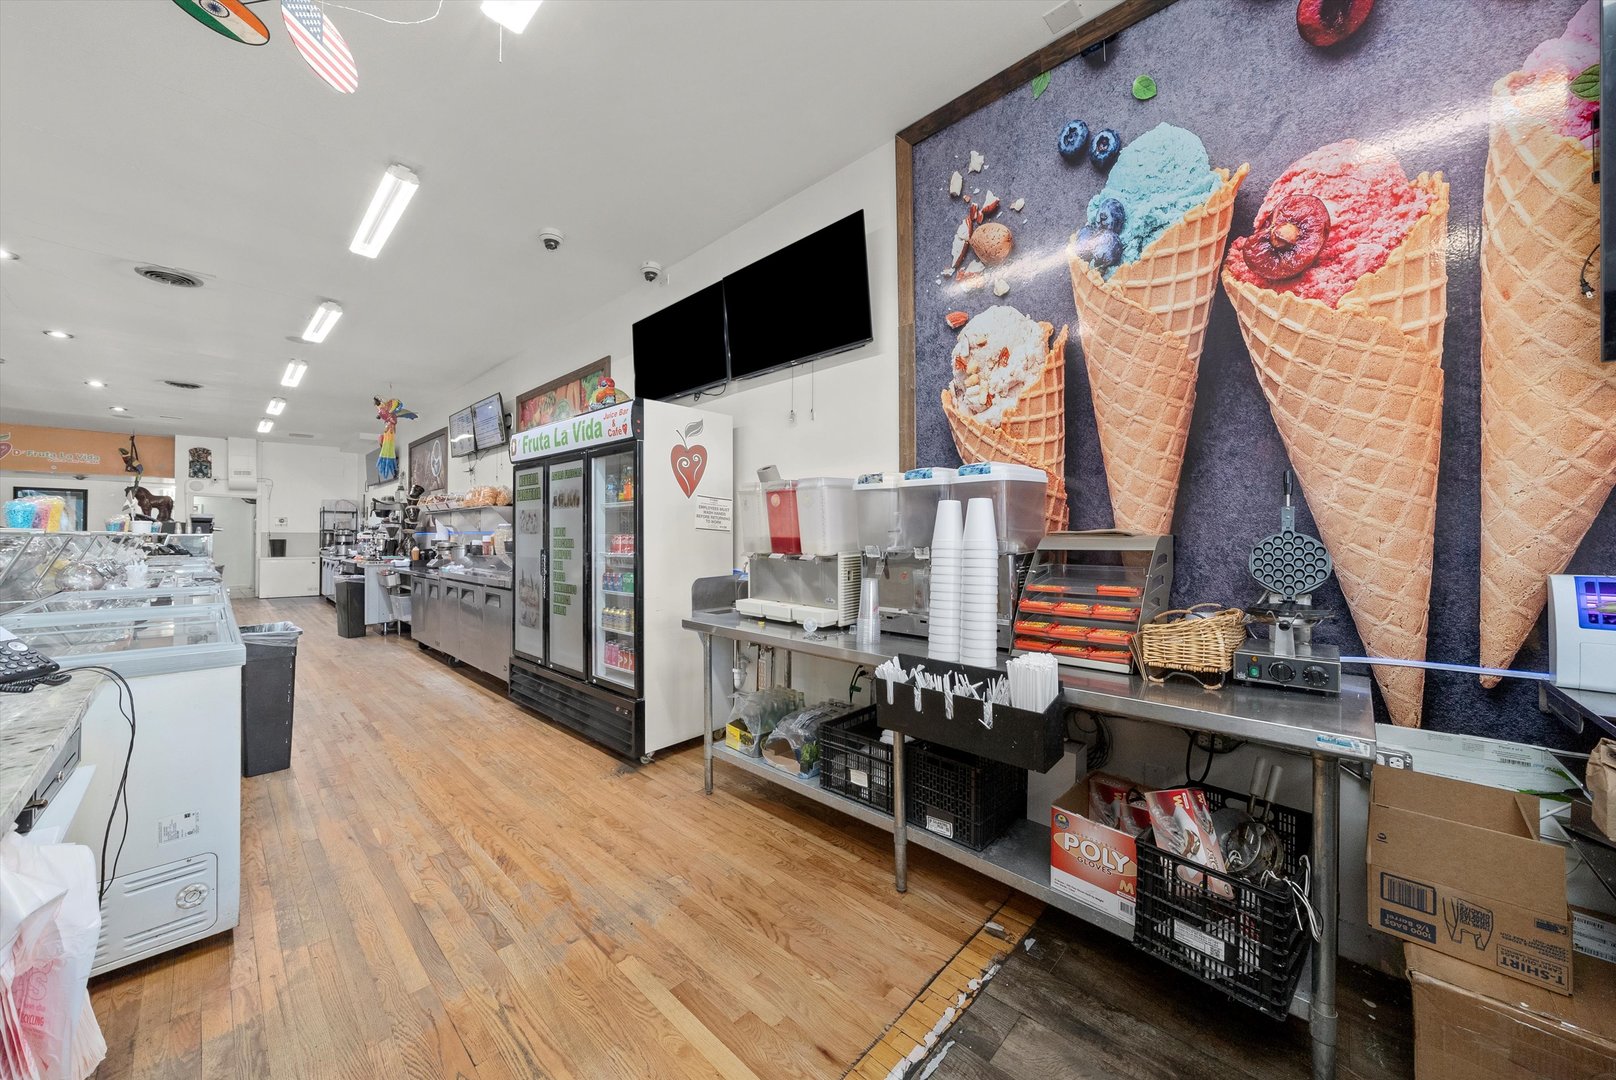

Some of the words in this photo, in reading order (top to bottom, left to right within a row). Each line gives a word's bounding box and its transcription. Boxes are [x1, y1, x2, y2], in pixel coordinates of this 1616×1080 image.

[602, 411, 618, 421] Juice
[618, 408, 629, 416] Bar
[522, 432, 551, 454] Fruta
[572, 418, 603, 443] Vida
[26, 450, 57, 460] Fruta
[59, 451, 73, 460] La
[76, 453, 101, 462] Vida
[1064, 832, 1130, 873] POLY
[1077, 856, 1112, 876] GLOVES
[1119, 879, 1135, 895] M
[1384, 918, 1408, 931] BAGS
[1386, 913, 1413, 927] Barrel
[1410, 927, 1432, 939] 1000
[1415, 923, 1430, 932] 1/6
[1500, 950, 1520, 960] BAGS
[1500, 956, 1565, 986] T-SHIRT
